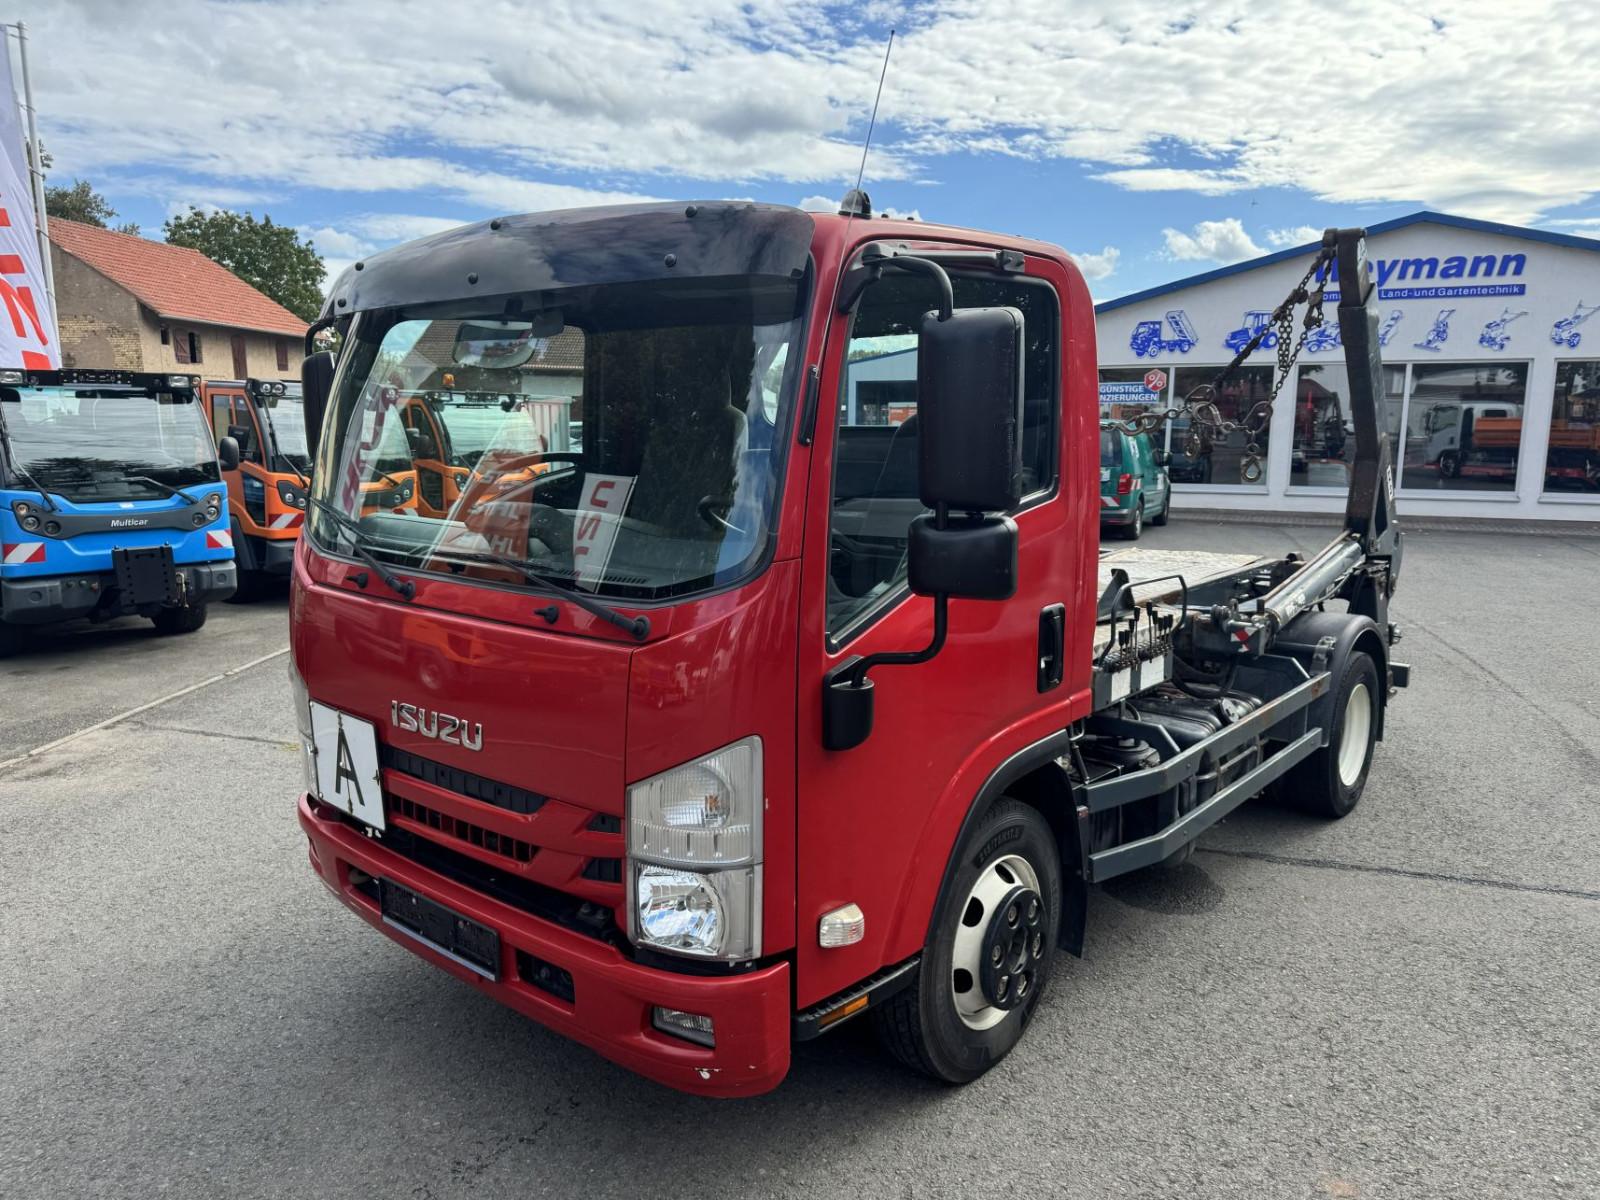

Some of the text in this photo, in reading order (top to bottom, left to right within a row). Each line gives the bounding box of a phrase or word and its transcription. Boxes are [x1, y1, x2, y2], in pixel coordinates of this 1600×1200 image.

[1315, 252, 1527, 288] ymann
[1437, 283, 1520, 297] Gartentechnik
[1099, 384, 1145, 393] GÜNSTIGE
[1099, 393, 1157, 401] NZIERUNGEN
[110, 518, 149, 528] Multicar
[391, 700, 483, 751] ISUZU
[335, 727, 366, 807] A
